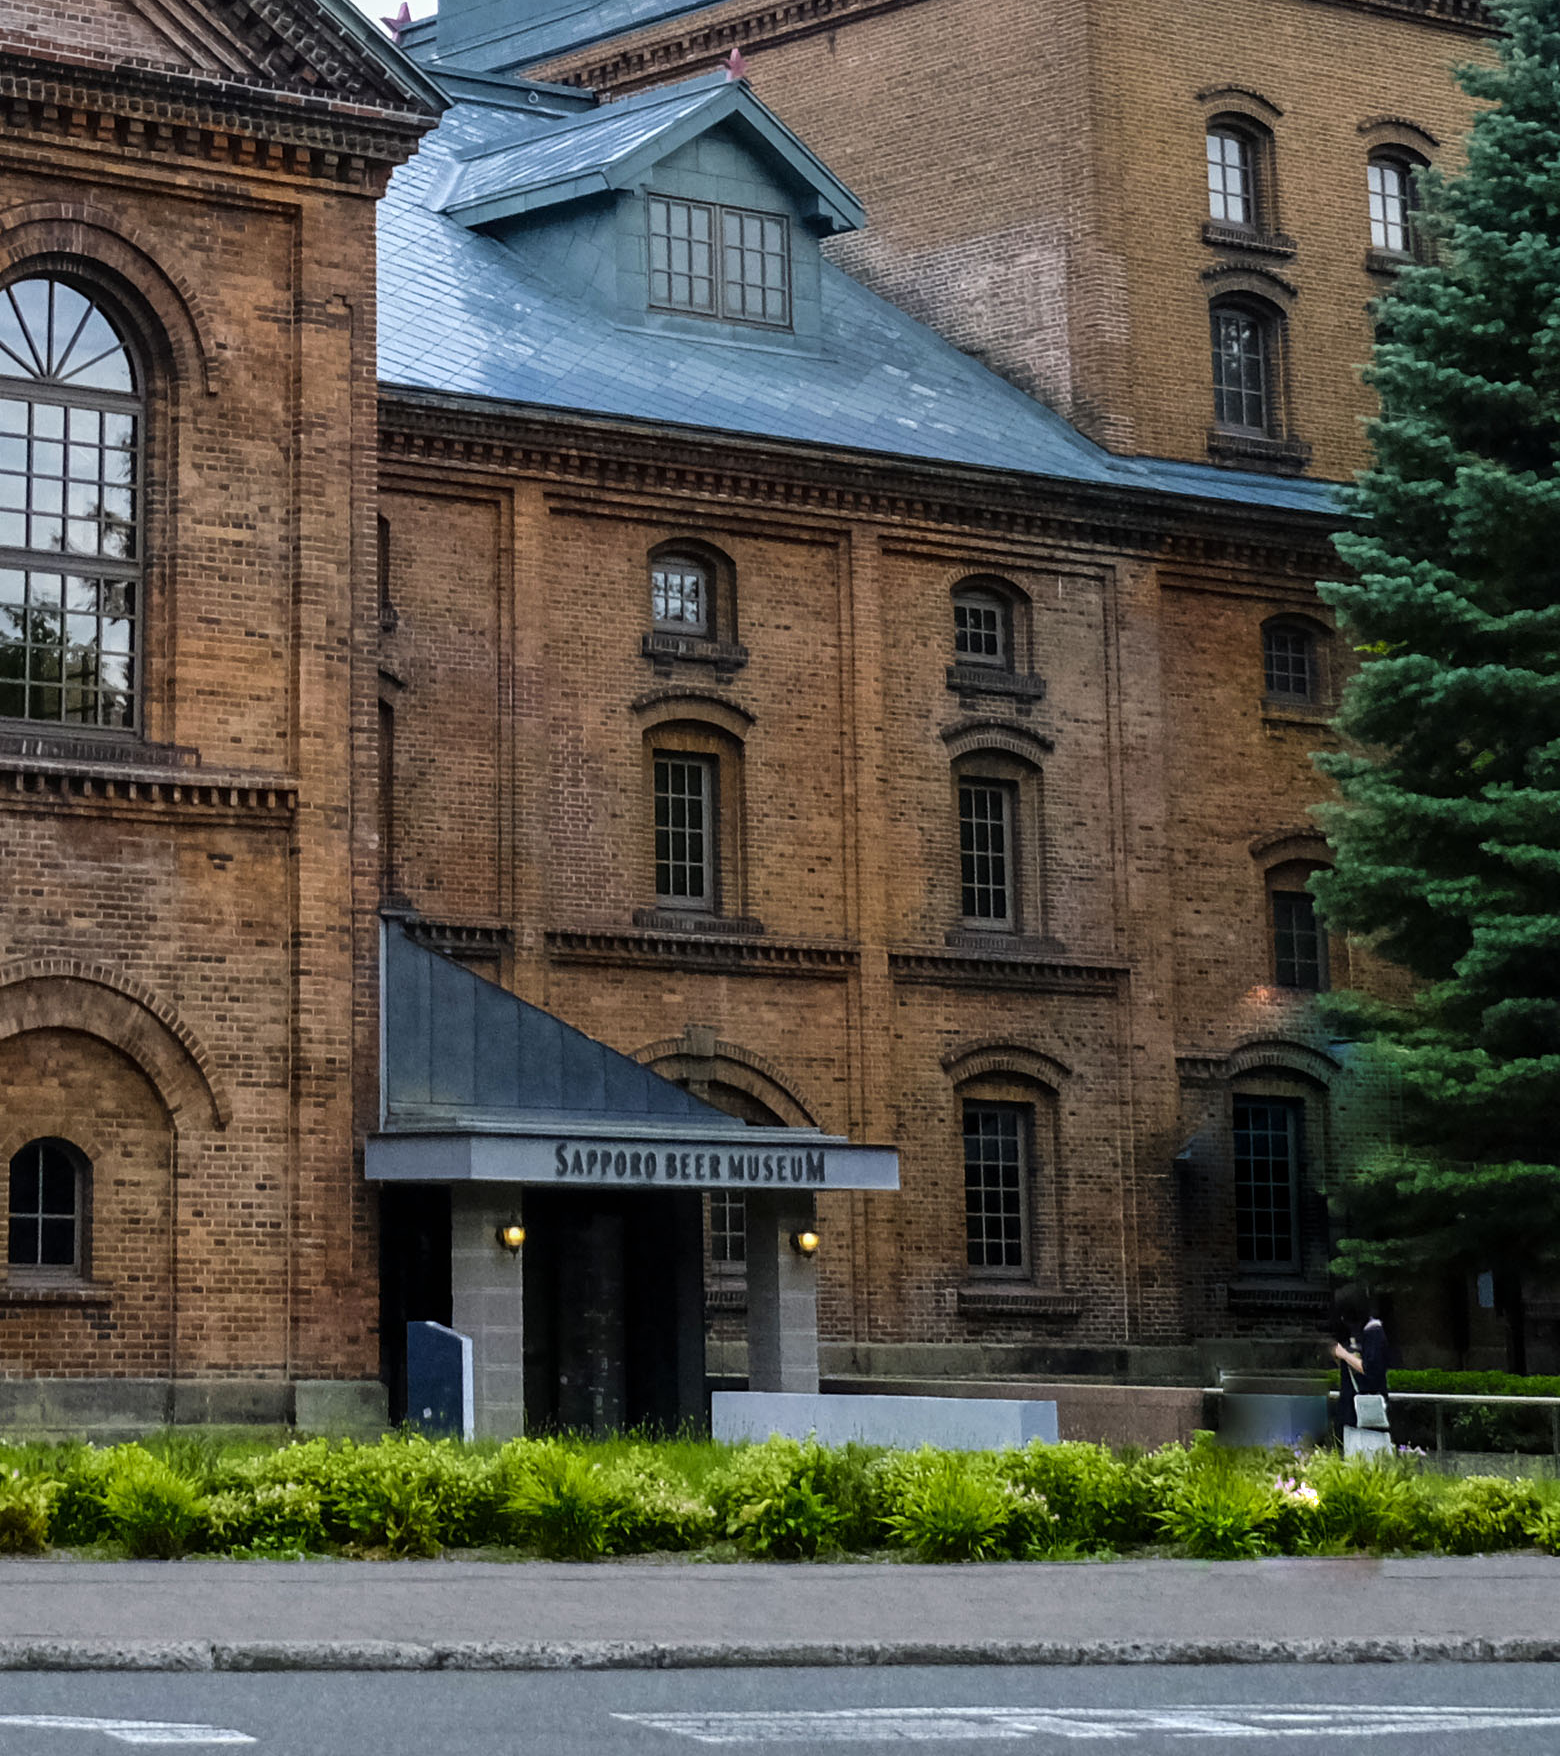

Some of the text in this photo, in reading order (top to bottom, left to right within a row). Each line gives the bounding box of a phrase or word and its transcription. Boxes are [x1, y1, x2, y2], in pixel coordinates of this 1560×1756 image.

[555, 1143, 825, 1183] SAPPORO BEER MUSEUM
